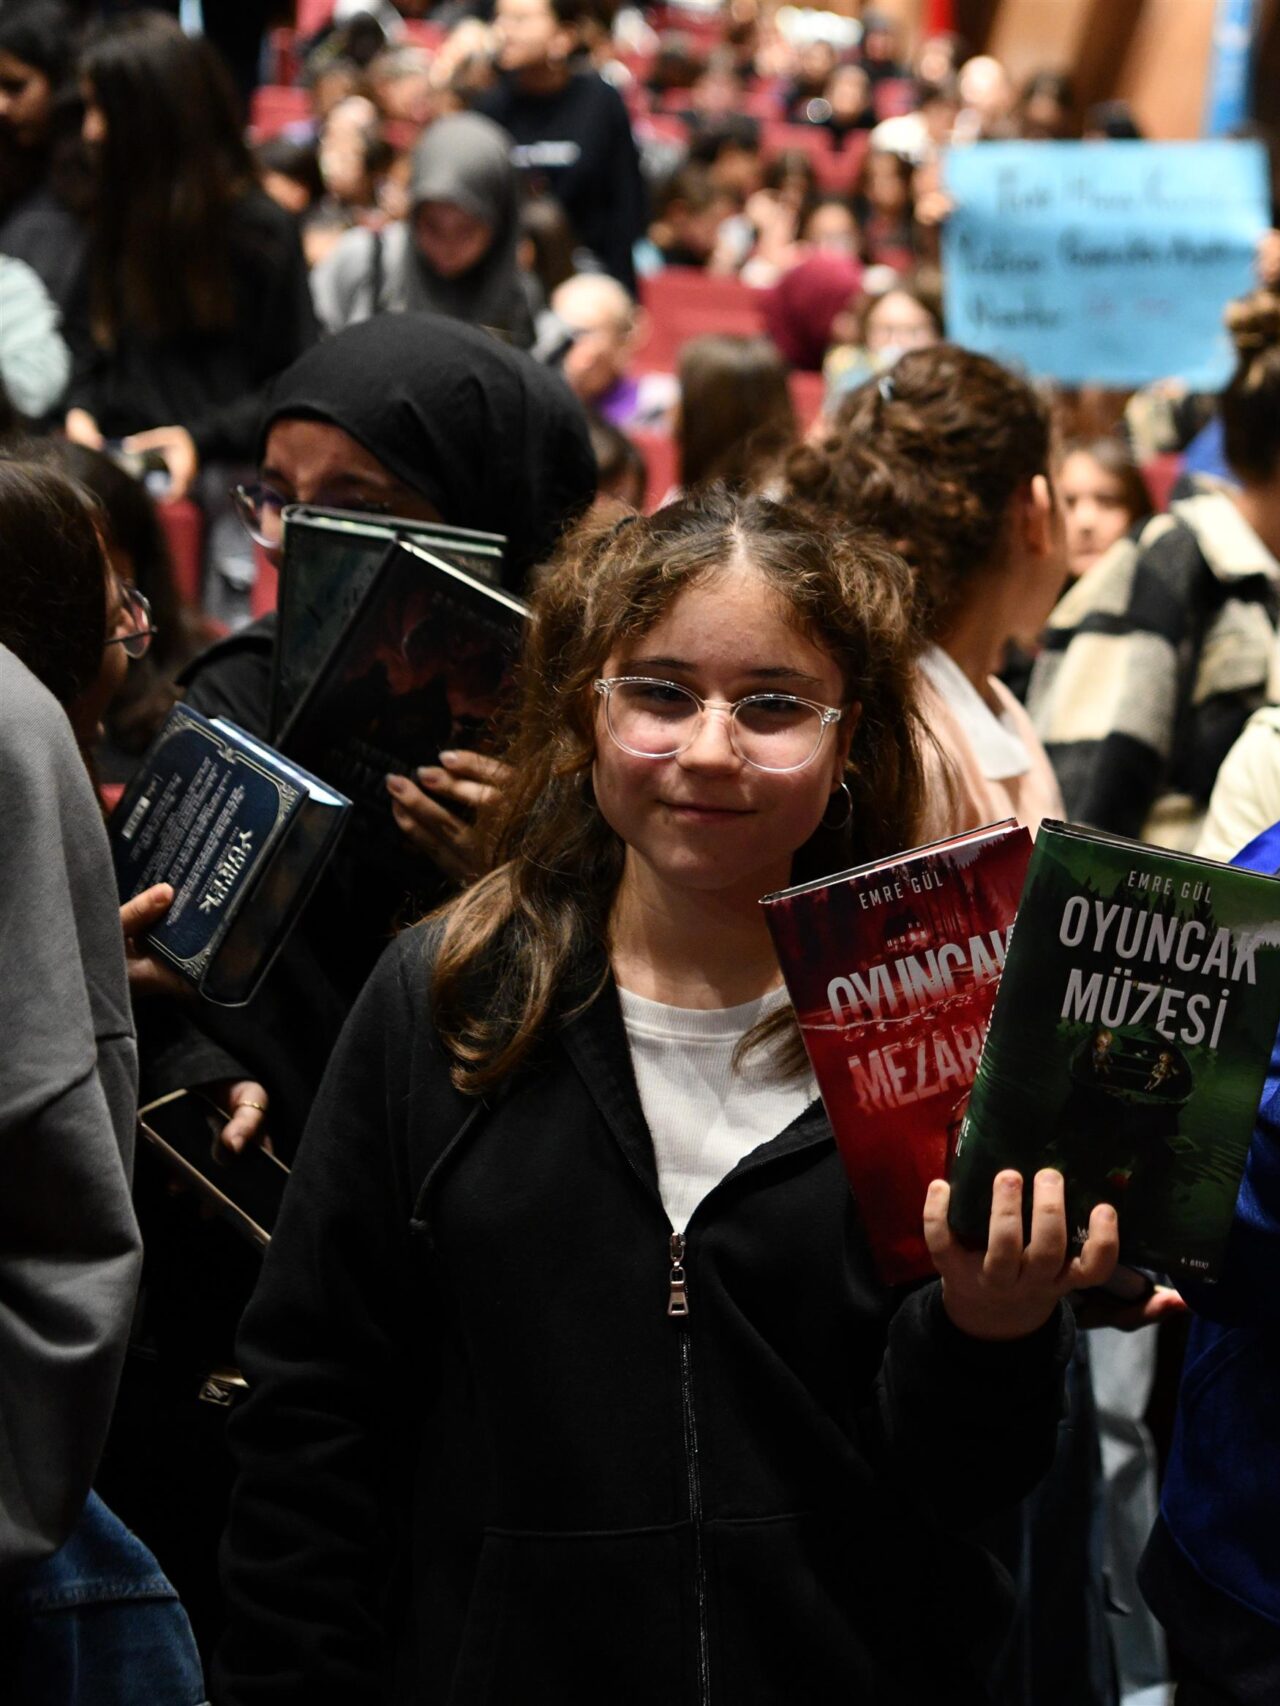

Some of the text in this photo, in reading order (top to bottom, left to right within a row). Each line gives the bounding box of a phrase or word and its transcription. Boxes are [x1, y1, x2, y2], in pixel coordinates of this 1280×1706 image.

[859, 870, 944, 910] EMRE GÜL
[1127, 870, 1212, 904] EMRE GÜL
[1059, 895, 1257, 985] OYUNCAK
[848, 1019, 987, 1112] MEZAR
